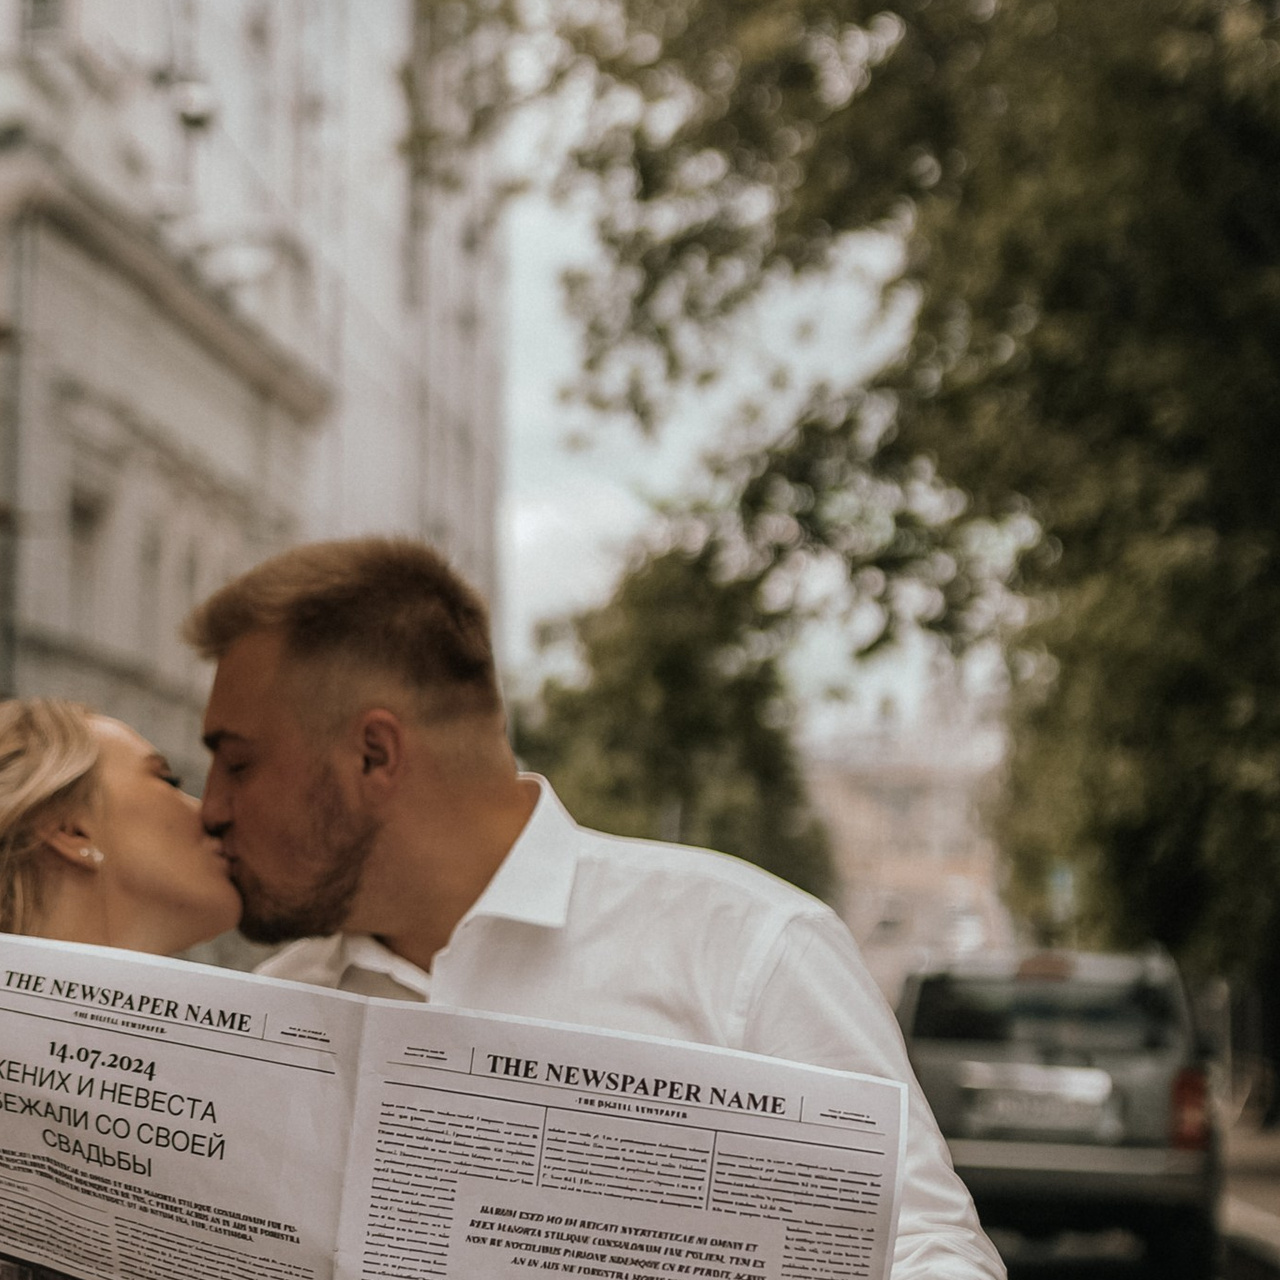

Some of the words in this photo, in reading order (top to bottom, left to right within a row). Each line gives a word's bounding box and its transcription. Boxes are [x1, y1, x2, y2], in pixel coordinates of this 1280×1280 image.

[5, 970, 46, 993] THE
[50, 978, 180, 1019] NEWSPAPER
[184, 1004, 252, 1033] NAME
[49, 1041, 157, 1081] 14.07.2024
[487, 1054, 539, 1079] THE
[545, 1062, 702, 1104] NEWSPAPER
[709, 1086, 787, 1116] NAME
[77, 1075, 95, 1098] И
[100, 1080, 217, 1124] НЕВЕСТА
[42, 1128, 152, 1177] СВАДЬБЫ
[95, 1114, 131, 1139] СО
[137, 1122, 226, 1161] СВОЕЙ
